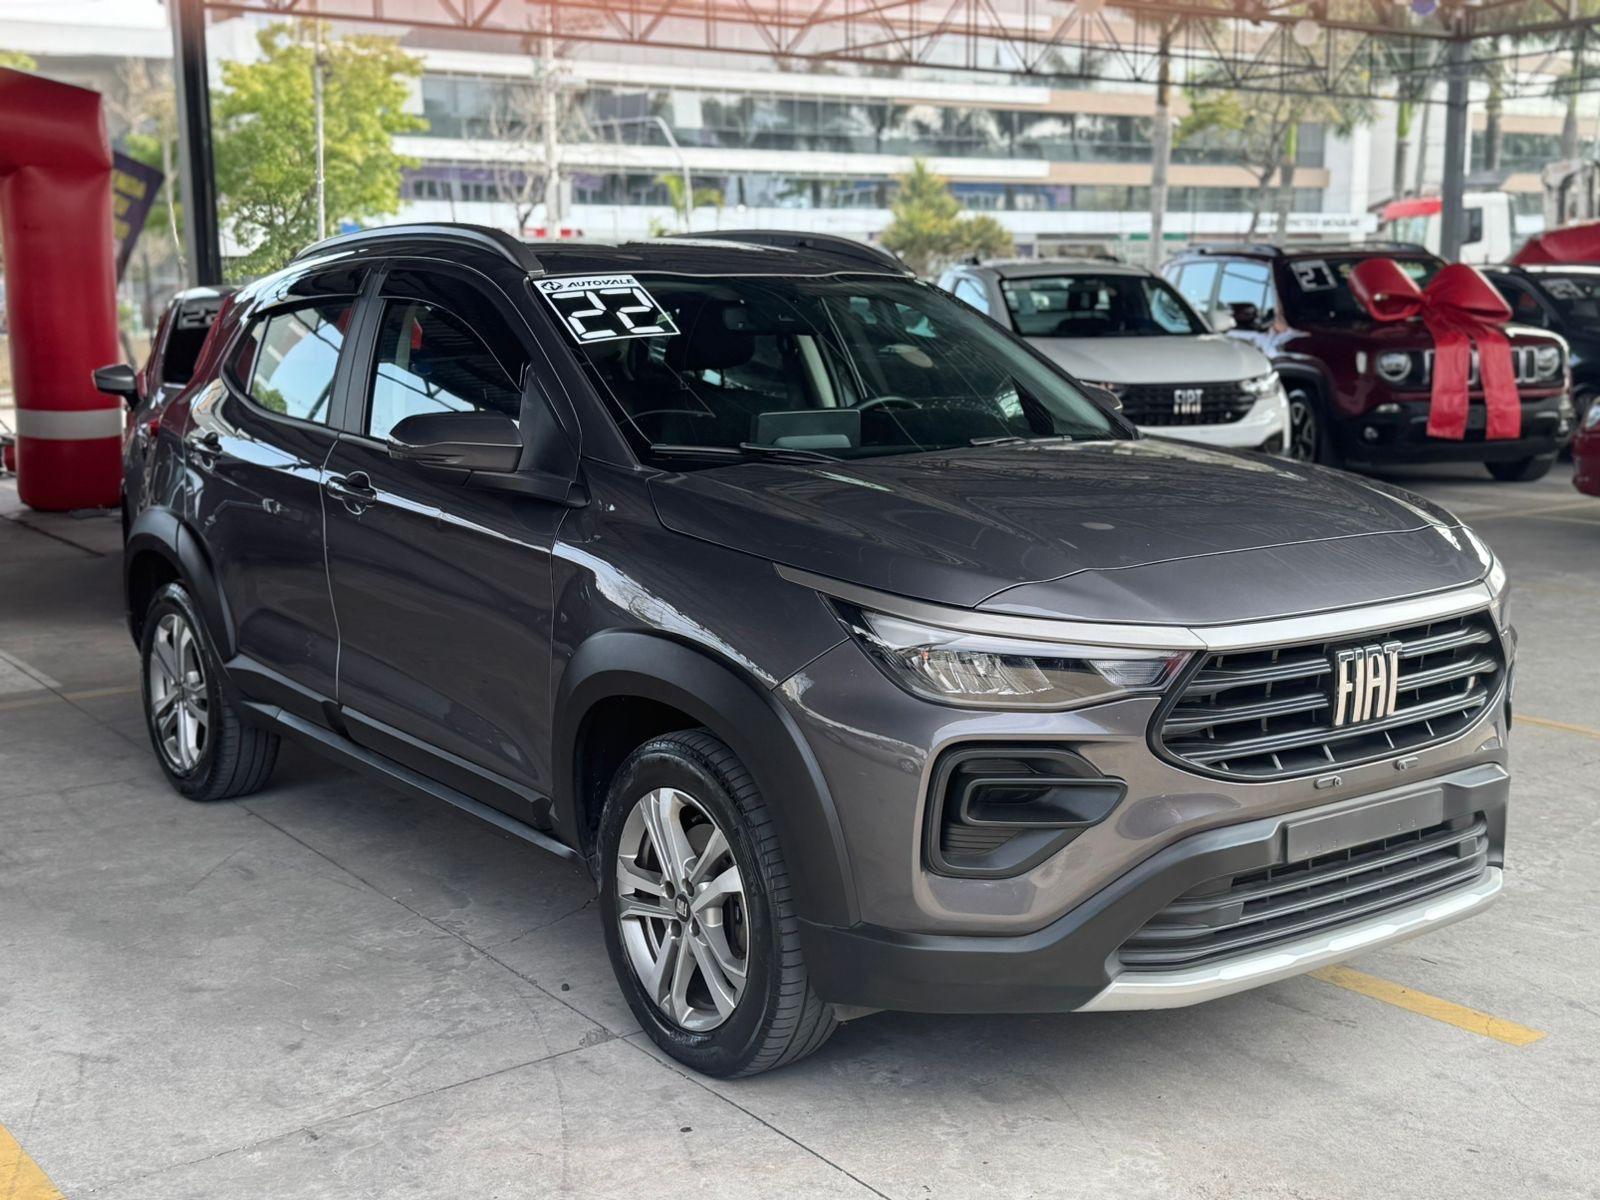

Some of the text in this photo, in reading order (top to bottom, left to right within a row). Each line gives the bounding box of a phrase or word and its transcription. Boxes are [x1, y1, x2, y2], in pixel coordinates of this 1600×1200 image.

[567, 278, 634, 288] AUTOVALE
[552, 287, 666, 339] 22
[1173, 389, 1204, 415] FIAT
[1334, 641, 1402, 726] FIAT
